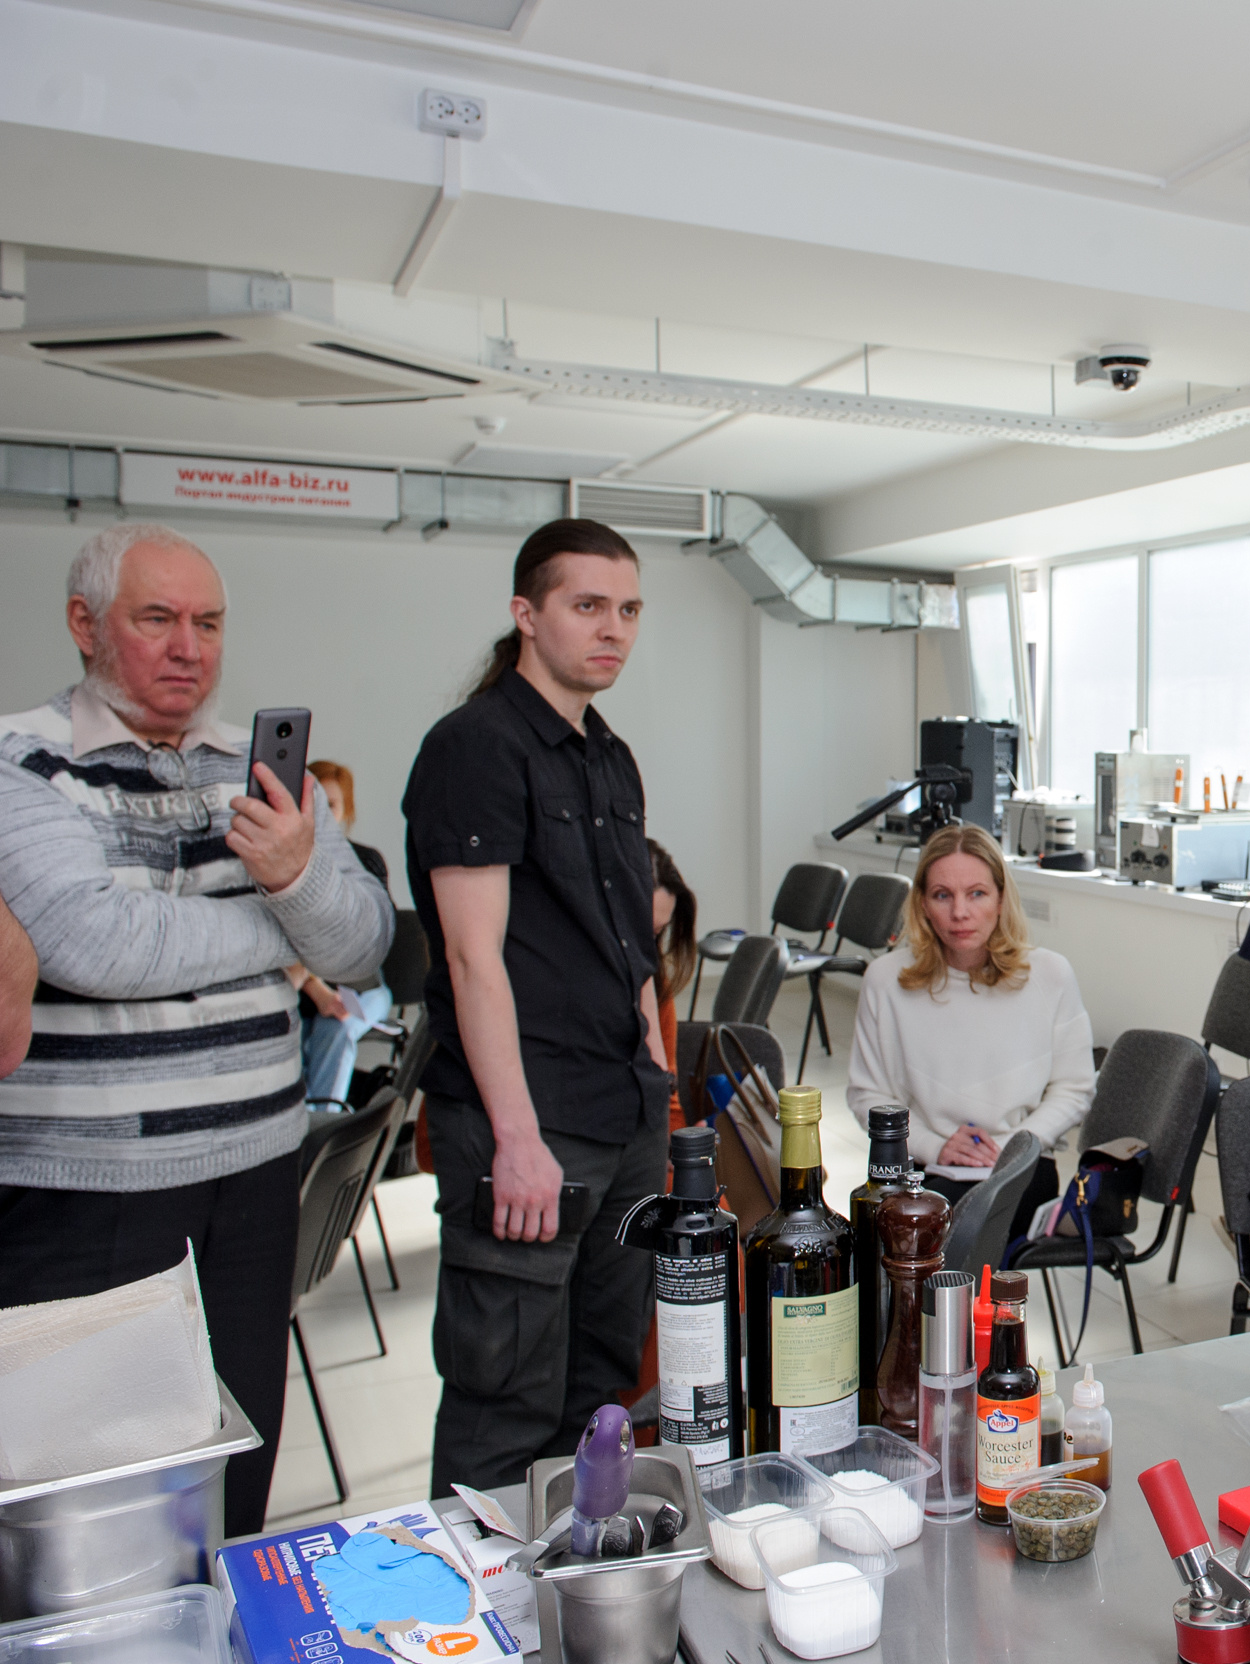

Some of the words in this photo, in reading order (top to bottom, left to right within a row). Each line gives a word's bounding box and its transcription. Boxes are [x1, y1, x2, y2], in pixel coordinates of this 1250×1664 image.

[177, 469, 349, 493] www.alfa-biz.ru
[175, 486, 223, 499] Портал
[226, 492, 295, 505] индустрии
[297, 497, 352, 508] питания
[869, 1163, 903, 1175] FRANCI
[786, 1304, 824, 1312] SALVAGNO
[990, 1419, 1014, 1428] Appel
[978, 1433, 1034, 1453] Worcester
[985, 1450, 1021, 1465] Sauce
[253, 1549, 273, 1581] ОДНОРАЗОВЫЕ
[278, 1541, 302, 1577] НИТРИЛОВЫЕ
[432, 1637, 448, 1655] РАЗМЕР
[444, 1636, 472, 1650] L
